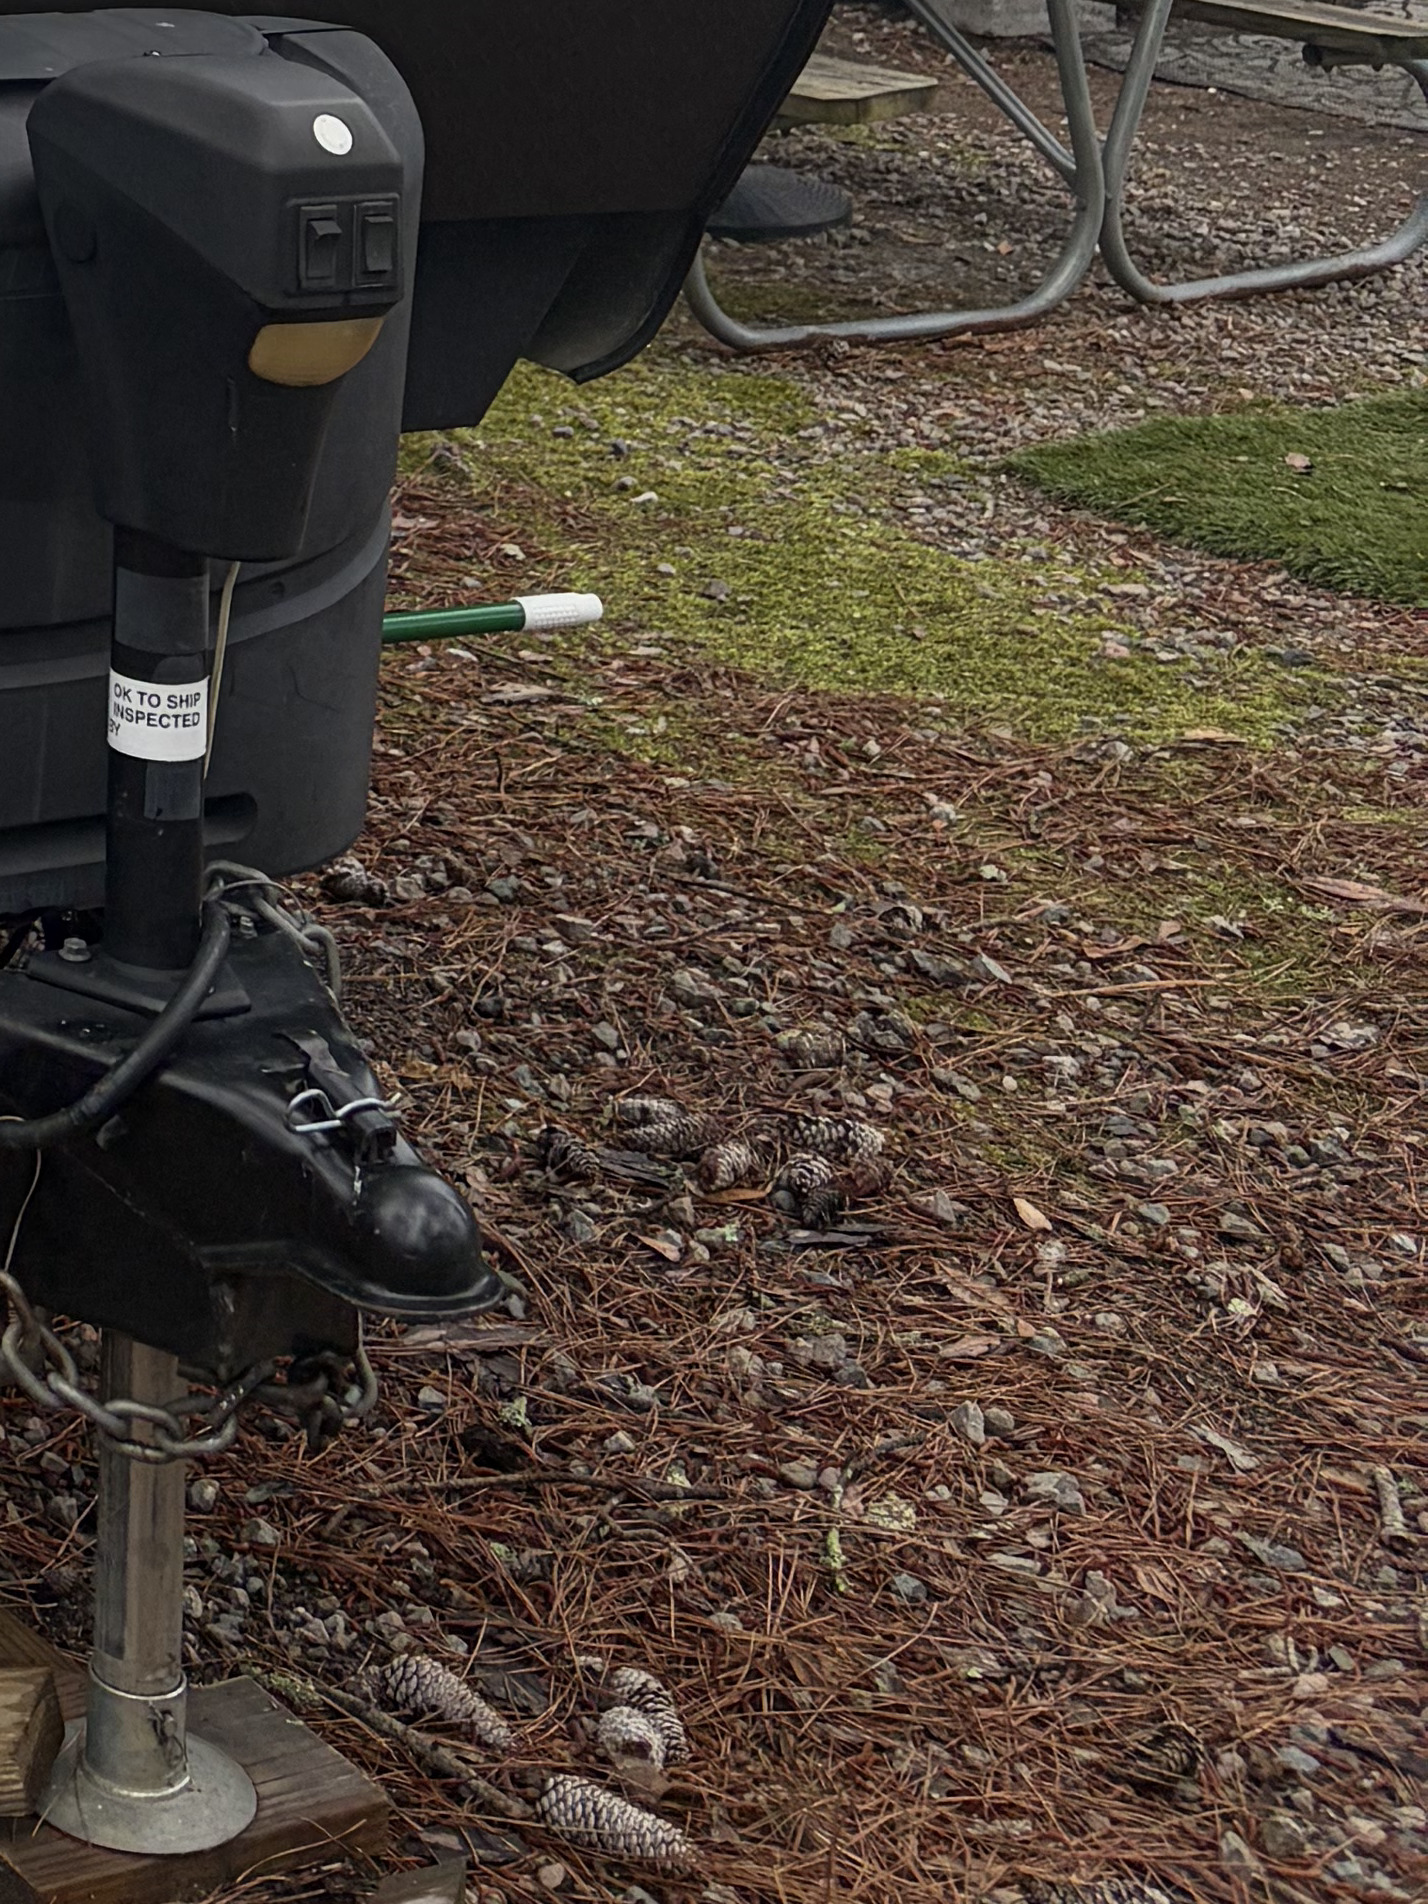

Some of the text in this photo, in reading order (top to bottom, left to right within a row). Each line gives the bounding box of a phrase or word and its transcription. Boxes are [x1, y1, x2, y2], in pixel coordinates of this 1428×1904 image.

[114, 683, 201, 709] OK TO SHIP
[114, 702, 200, 728] INSPECTED
